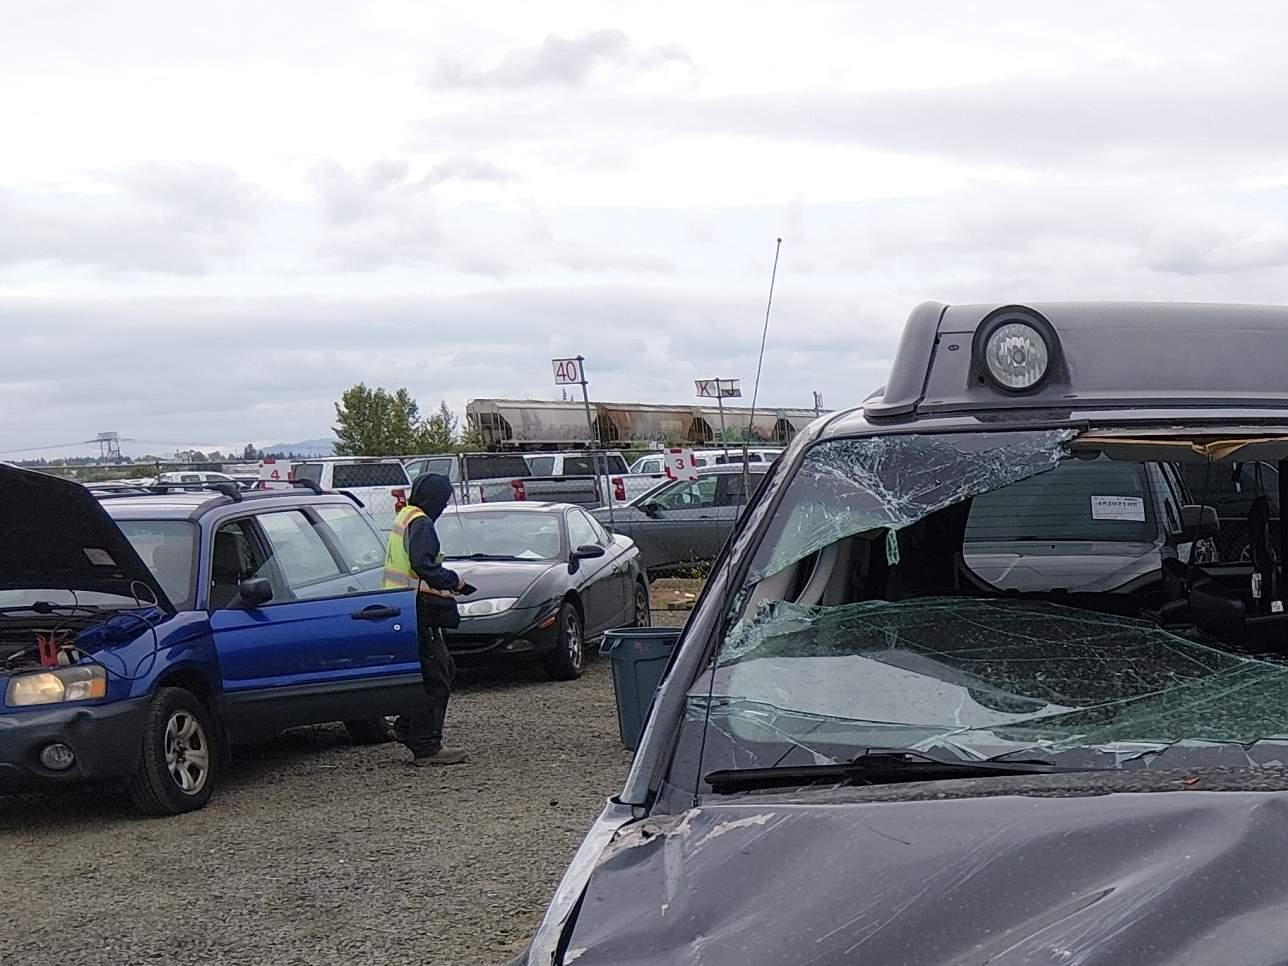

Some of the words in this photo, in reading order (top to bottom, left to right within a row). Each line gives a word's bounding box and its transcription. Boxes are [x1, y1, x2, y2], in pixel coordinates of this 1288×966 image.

[556, 361, 577, 381] 40
[699, 381, 711, 396] K
[675, 458, 685, 470] 3
[270, 469, 280, 480] 4
